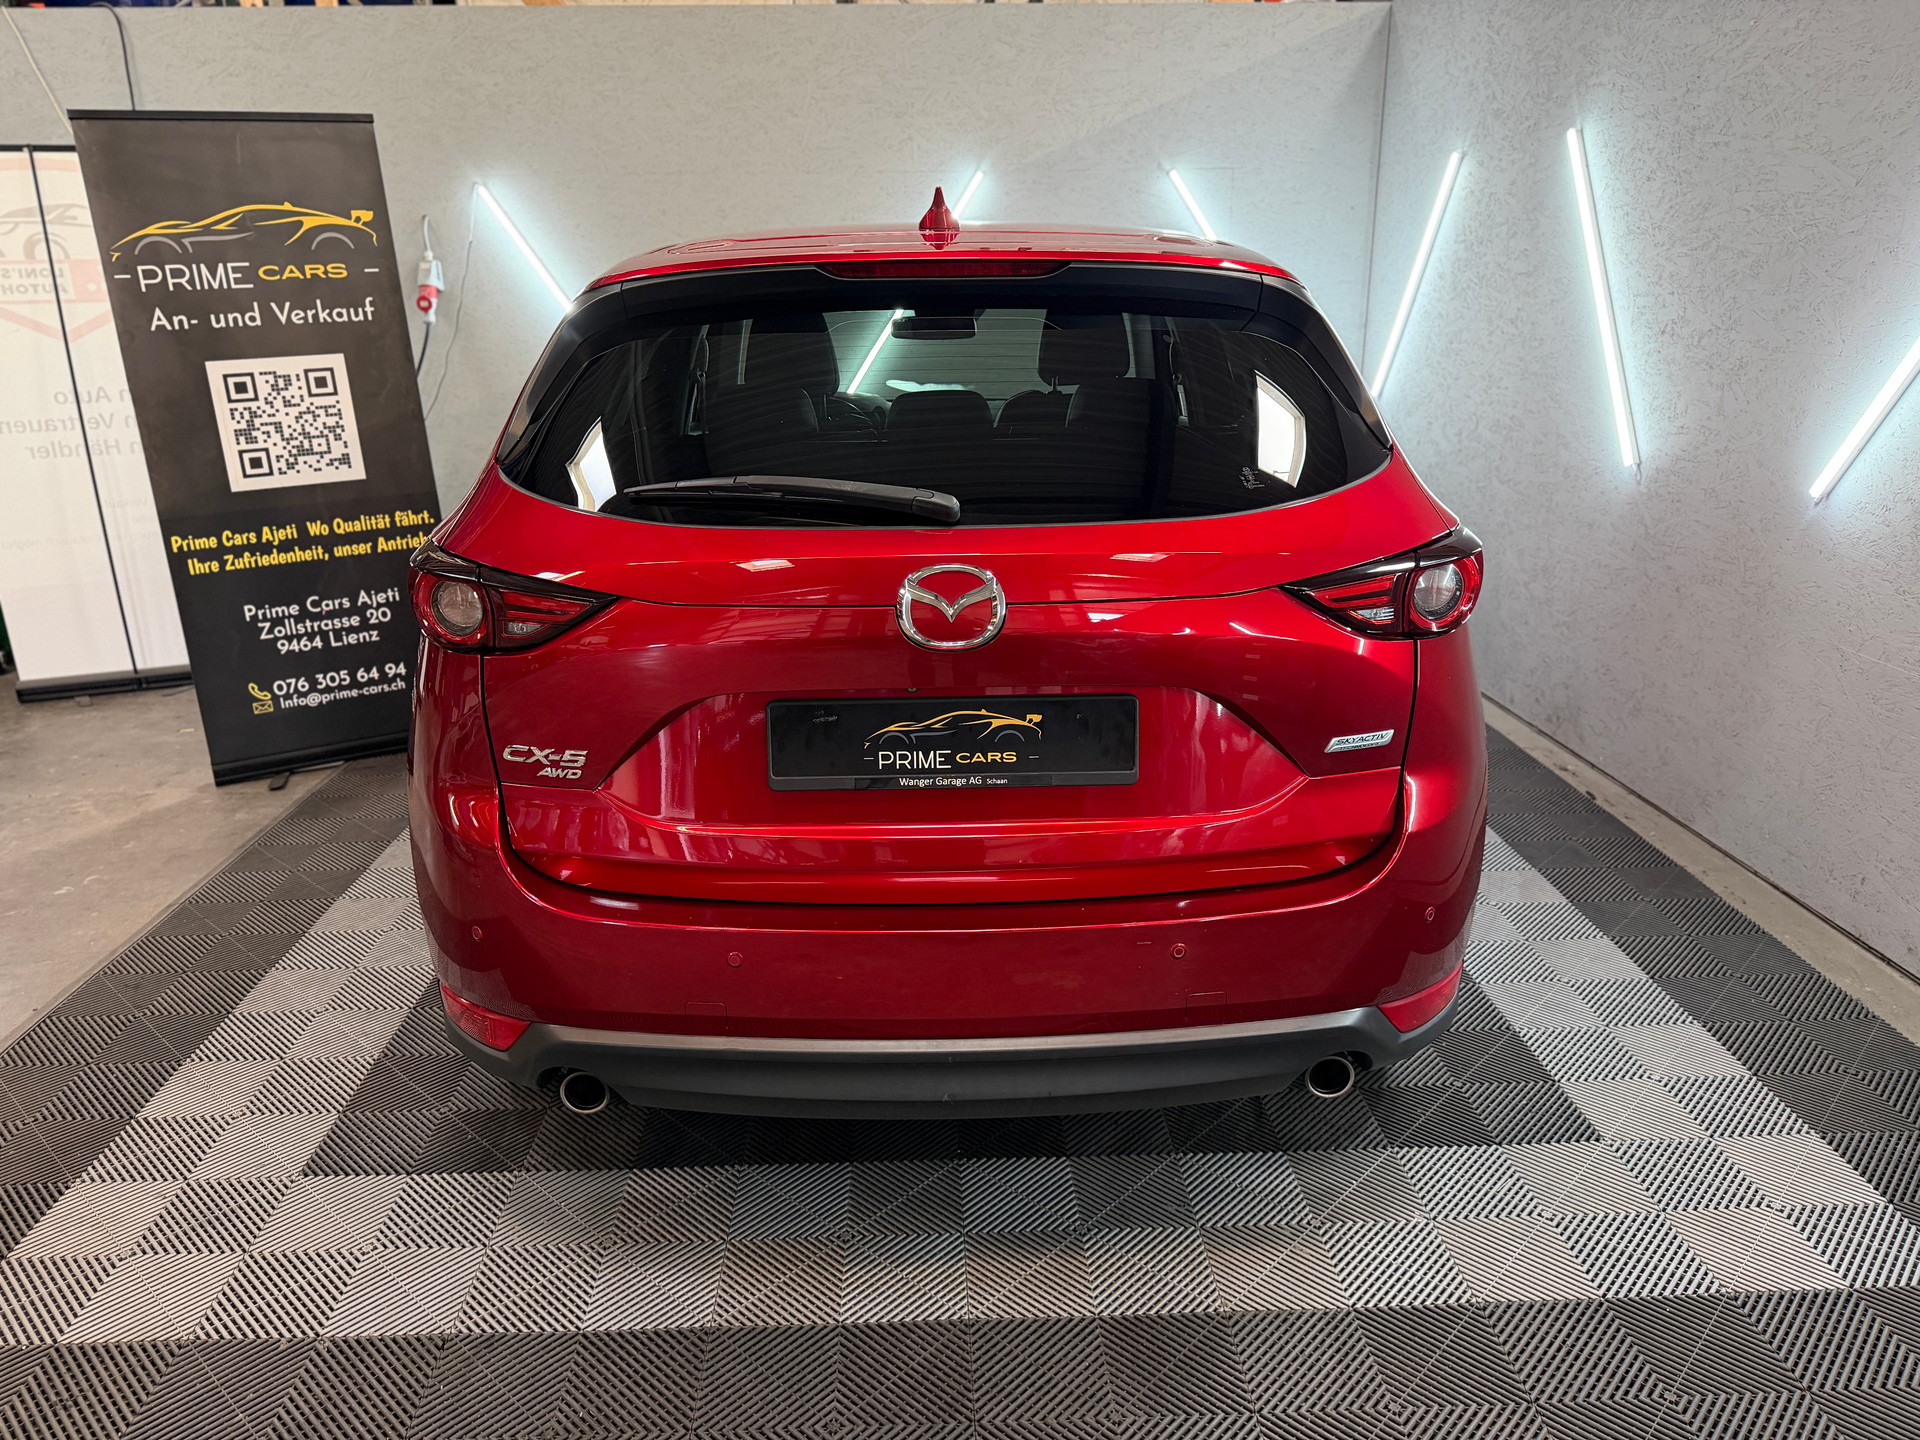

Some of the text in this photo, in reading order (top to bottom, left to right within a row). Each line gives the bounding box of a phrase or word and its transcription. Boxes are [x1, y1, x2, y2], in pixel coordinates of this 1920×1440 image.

[137, 262, 348, 292] PRIME CARS
[150, 298, 375, 332] An- und Verkauf
[170, 535, 218, 553] Prime
[221, 529, 257, 547] Cars
[261, 524, 298, 546] Ajeti
[306, 521, 329, 537] Wo
[333, 514, 391, 535] Qualität
[394, 510, 435, 528] fährt.
[187, 557, 220, 575] Ihre
[224, 546, 329, 571] Zufriedenheit,
[334, 541, 372, 558] unser
[243, 588, 400, 621] Prime Cars Ajeti
[257, 607, 392, 639] Zollstrasse 20
[276, 628, 380, 655] 9464 Lienz
[272, 662, 407, 696] 076 305 64 94
[280, 678, 406, 709] Info@prime-cars.ch
[1337, 732, 1389, 744] SKYACTIV
[502, 744, 588, 767] CX-5
[878, 750, 1017, 770] PRIME CARS
[536, 767, 582, 779] AWD
[899, 776, 1008, 788] Wanger Garage AG Schaan
